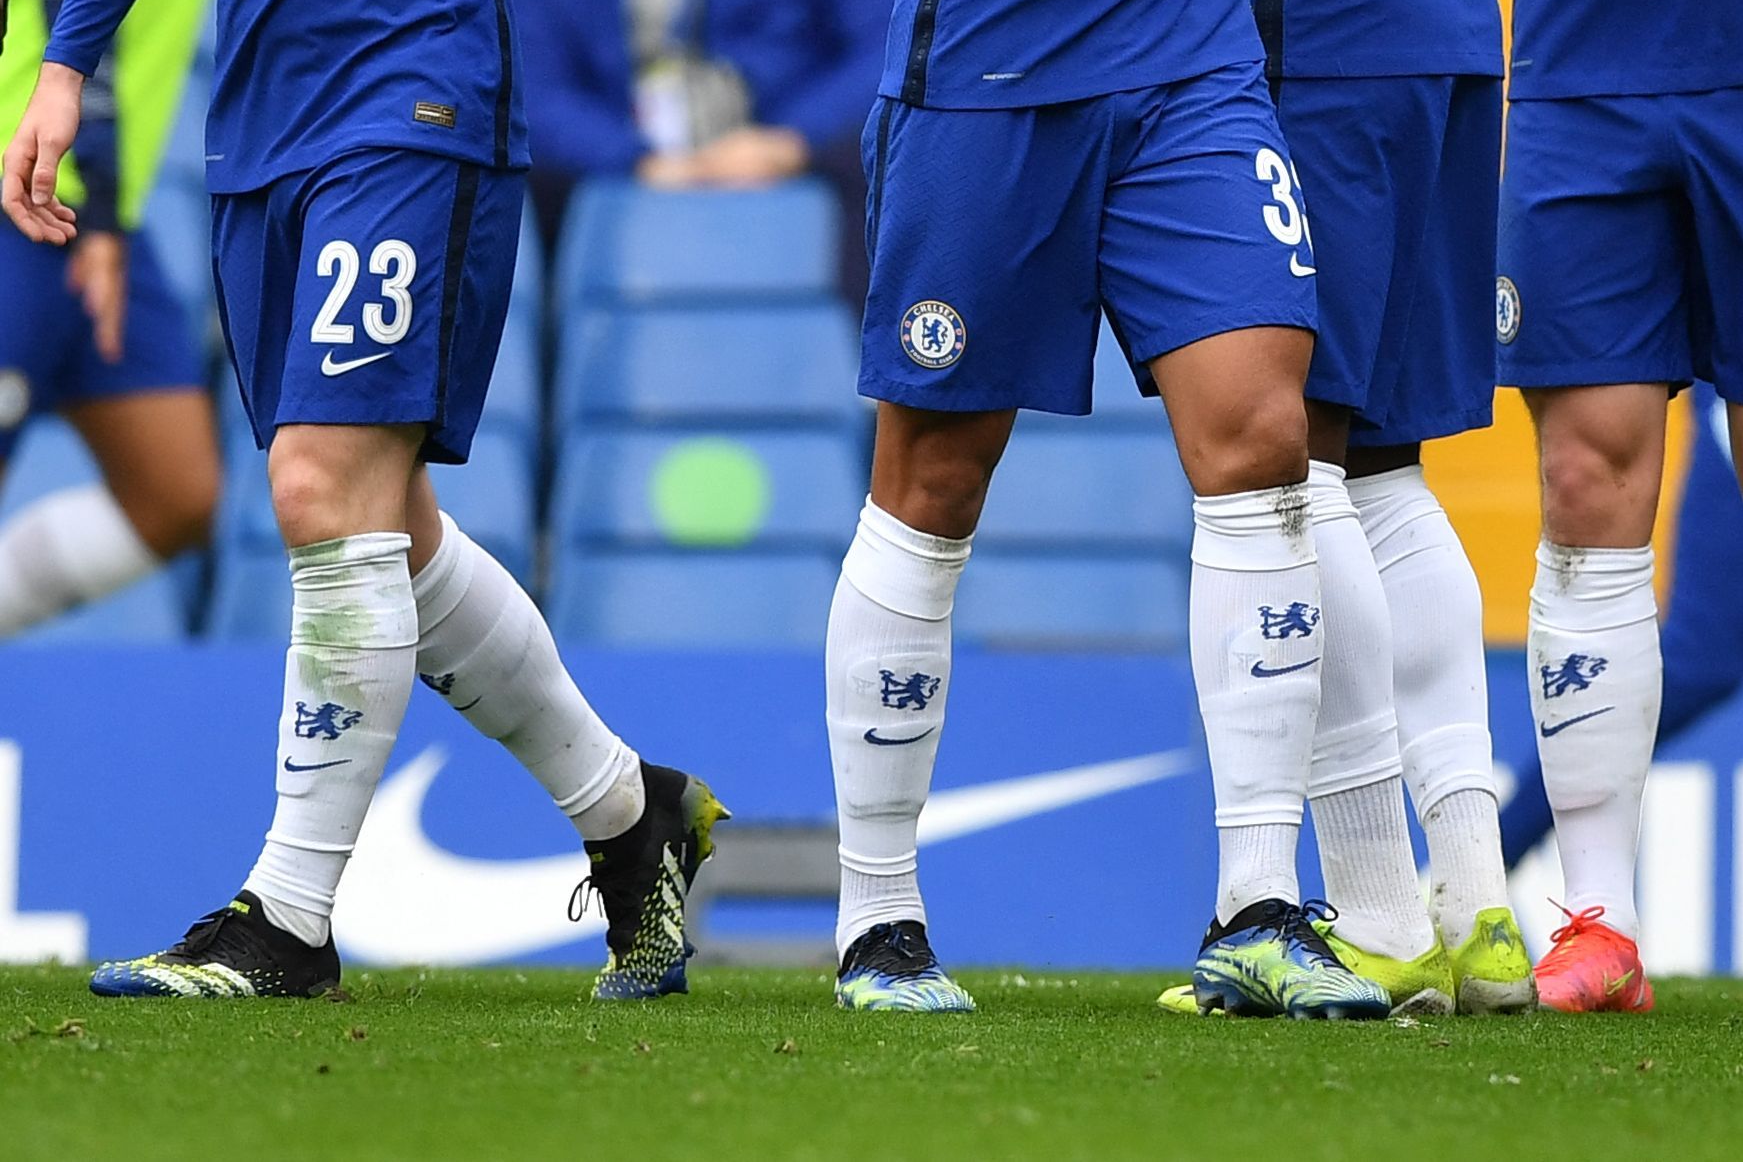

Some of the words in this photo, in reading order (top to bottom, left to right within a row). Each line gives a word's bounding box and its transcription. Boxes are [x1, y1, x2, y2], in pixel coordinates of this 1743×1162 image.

[1255, 148, 1314, 247] 3
[310, 239, 417, 345] 23
[912, 304, 955, 322] CHELSEA
